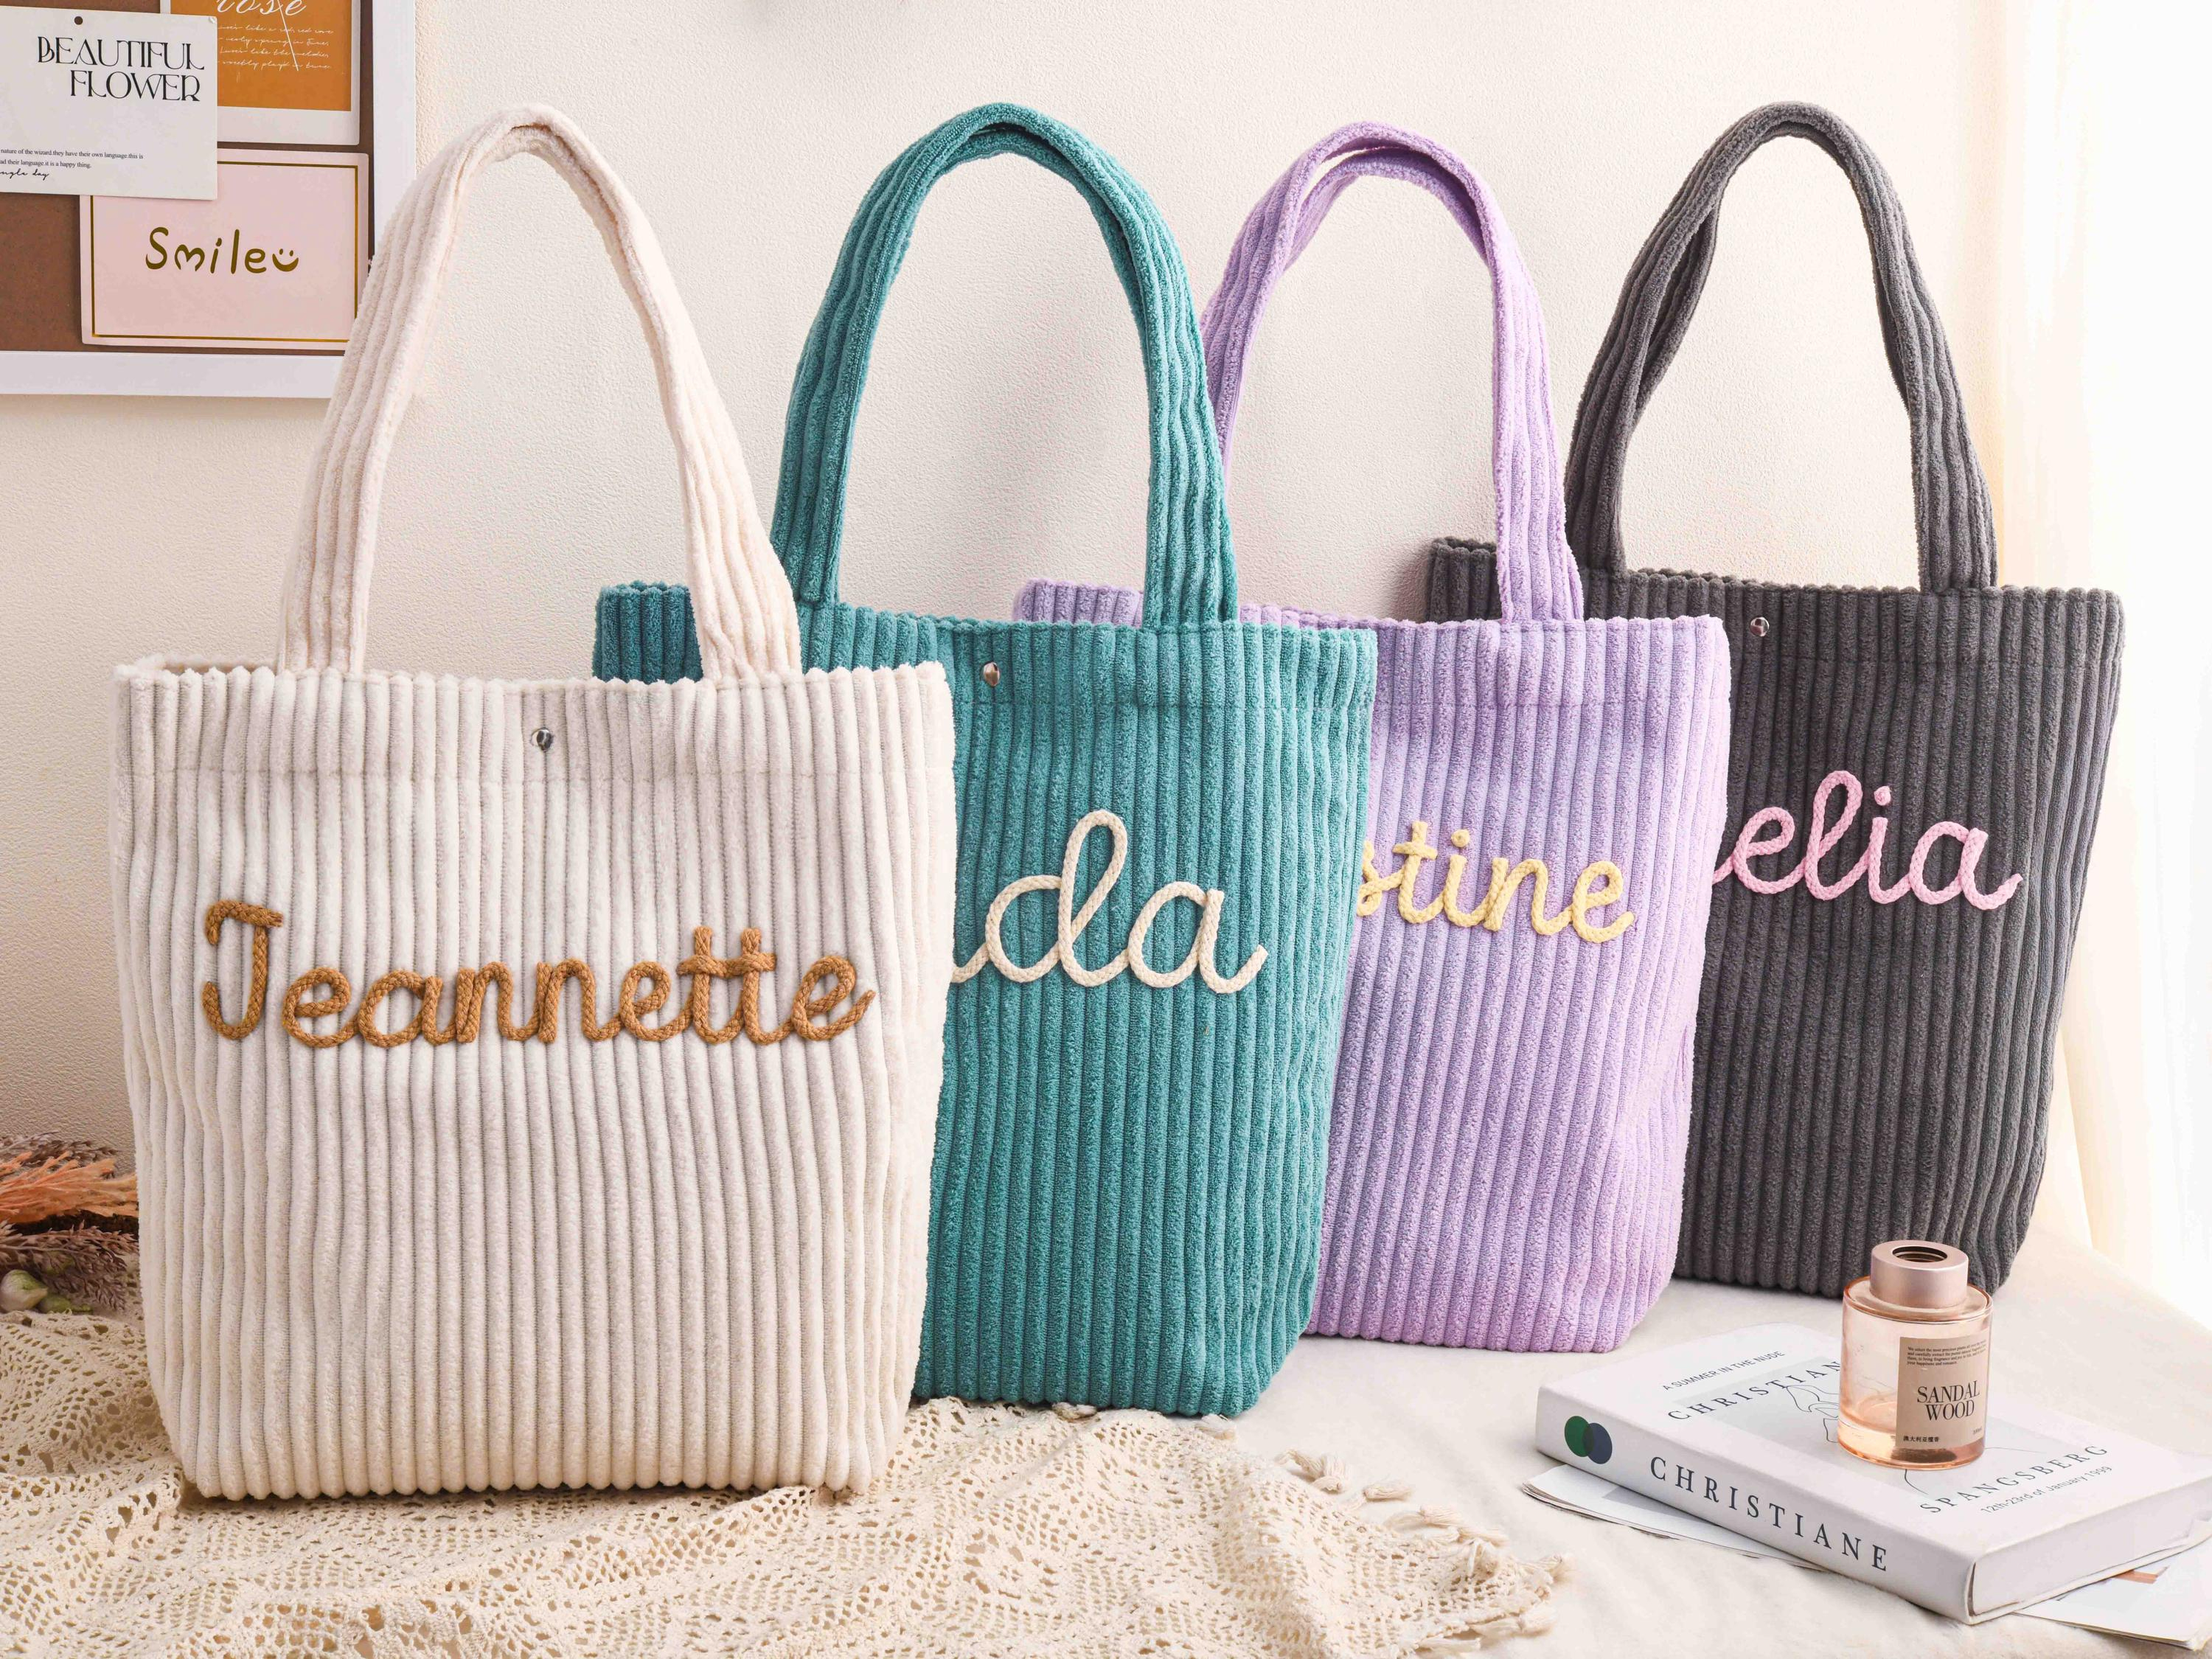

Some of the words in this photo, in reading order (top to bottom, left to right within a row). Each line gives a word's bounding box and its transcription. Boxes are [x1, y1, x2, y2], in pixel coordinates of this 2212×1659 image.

[38, 36, 205, 70] BEAUTIFUL
[71, 69, 201, 101] FLOWER
[60, 161, 76, 169] happy
[145, 226, 266, 274] Smile
[1712, 770, 2023, 911] elia
[950, 810, 1268, 994] da
[201, 899, 876, 1048] Jeannette
[1672, 1369, 1718, 1388] SUMMER
[1719, 1366, 1732, 1374] IN
[1731, 1358, 1756, 1369] THE
[1753, 1351, 1786, 1362] NUDE
[1917, 1380, 1980, 1403] SANDAL
[1924, 1399, 1975, 1421] WOOD
[1920, 1446, 2107, 1513] SPANGSBERG
[1980, 1492, 2033, 1513] 12th-23rd
[2033, 1488, 2044, 1496] of
[2048, 1475, 2088, 1492] January
[2084, 1465, 2112, 1480] 1999
[1650, 1456, 1887, 1571] CHRISTIANE
